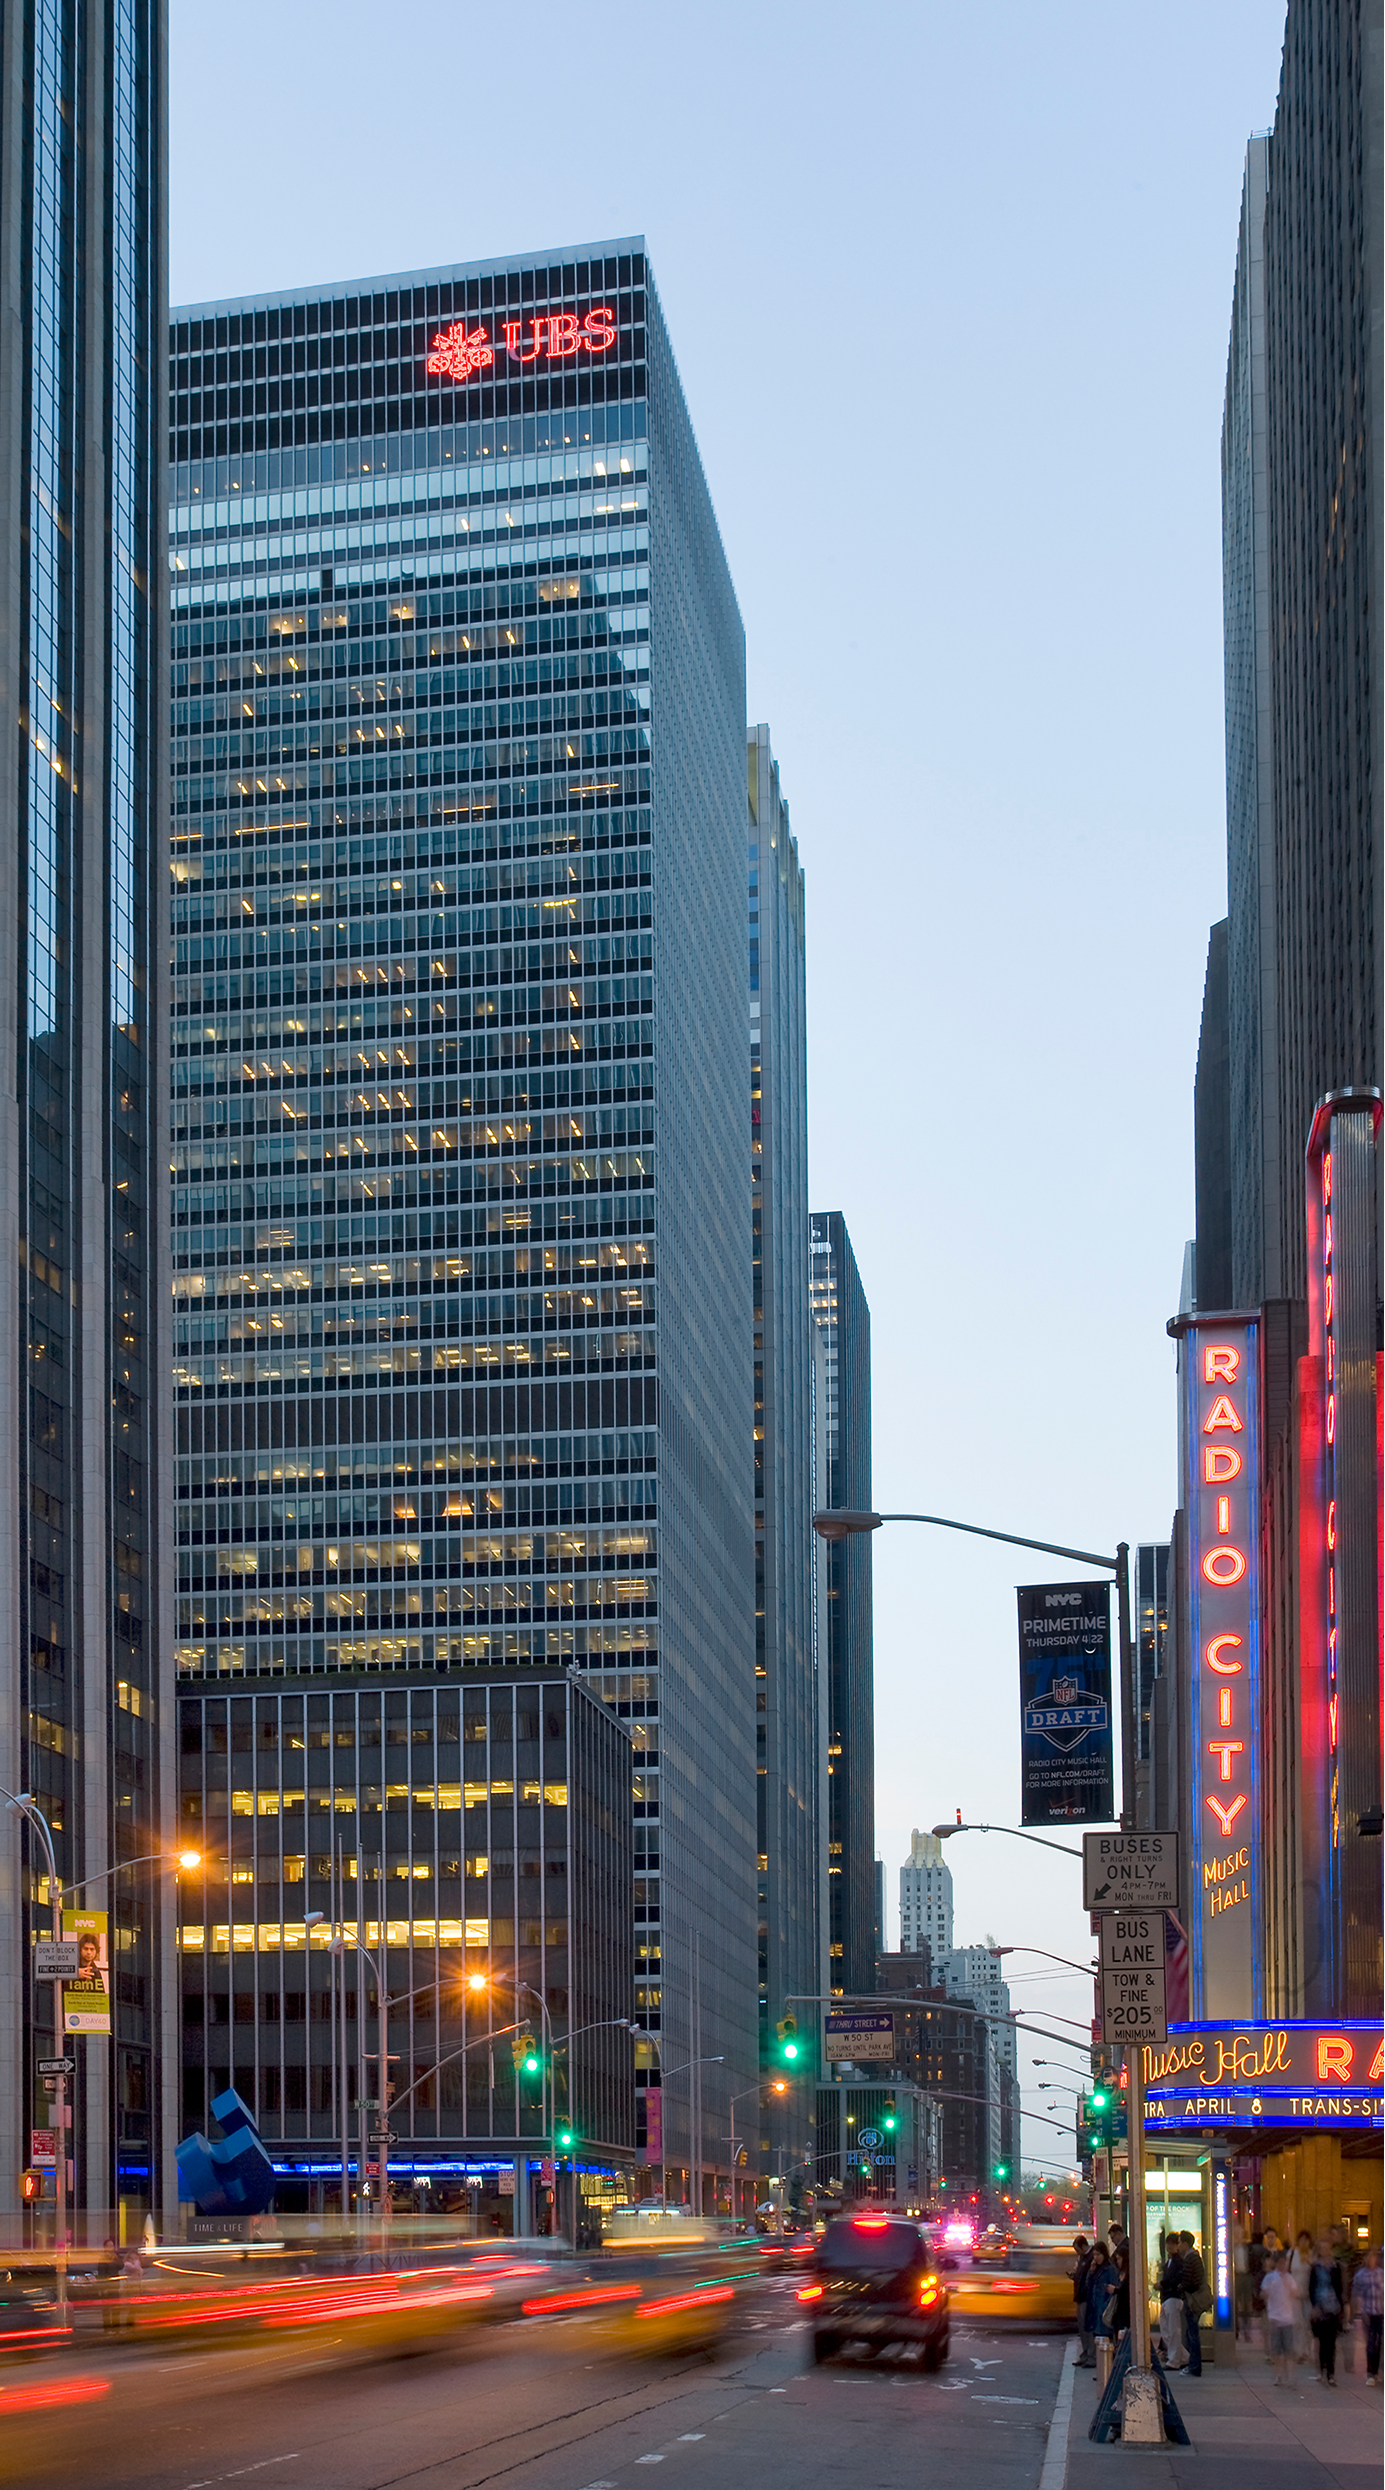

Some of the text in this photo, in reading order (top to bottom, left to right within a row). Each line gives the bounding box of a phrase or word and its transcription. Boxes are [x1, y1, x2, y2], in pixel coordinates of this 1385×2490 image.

[501, 307, 615, 362] UBS
[1202, 1345, 1246, 1587] RADIO
[1045, 1593, 1082, 1607] NYC
[1022, 1616, 1106, 1634] PRIMETIME
[1026, 1635, 1080, 1647] THURSDAY
[1056, 1689, 1075, 1702] NFL
[1031, 1709, 1100, 1727] DRAFT
[1205, 1633, 1247, 1836] CITY
[1028, 1760, 1050, 1768] RADIO
[1067, 1757, 1089, 1765] MUSIC
[1090, 1756, 1107, 1764] HALL
[1029, 1772, 1039, 1780] GO
[1051, 1769, 1105, 1779] NFL.COM/DRAFT
[1026, 1777, 1109, 1789] FOR MORE INFORMATION
[1100, 1838, 1163, 1854] BUSES
[1107, 1864, 1156, 1880] ONLY
[1114, 1892, 1134, 1901] MON
[1158, 1891, 1172, 1900] FRI
[74, 1919, 96, 1928] NYC
[1116, 1921, 1149, 1938] BUS
[1112, 1945, 1155, 1962] LANE
[1112, 1973, 1156, 1986] TOW &
[1120, 1989, 1149, 2002] FINE
[835, 2018, 878, 2029] THRU STREET
[864, 2033, 874, 2041] ST
[1115, 2029, 1156, 2039] MINIMUM
[1199, 2031, 1292, 2086] Hall
[1184, 2098, 1236, 2115] APRIL
[1251, 2098, 1263, 2115] 8
[193, 2223, 214, 2232] TIME
[223, 2223, 243, 2232] LIFE
